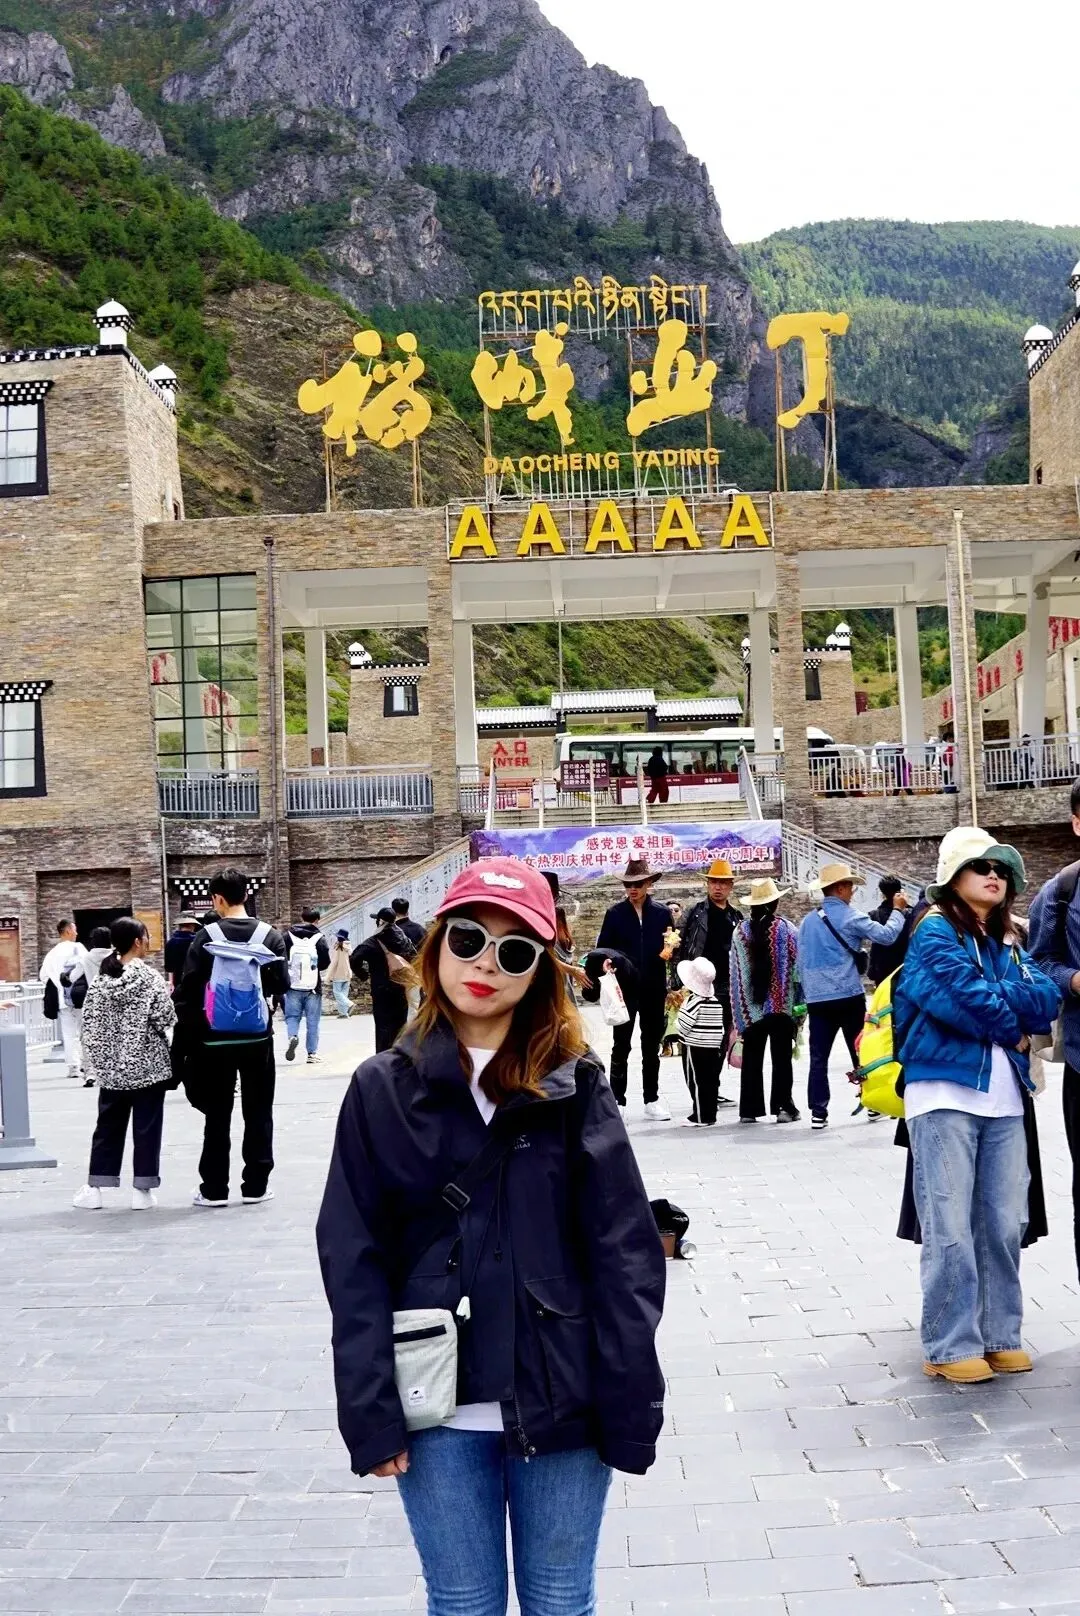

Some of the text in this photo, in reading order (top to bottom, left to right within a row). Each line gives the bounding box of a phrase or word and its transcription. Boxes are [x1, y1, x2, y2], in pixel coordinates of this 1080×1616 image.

[484, 448, 720, 475] DAOCHENG YADING
[493, 741, 527, 756] 入口
[586, 836, 674, 850] 感党恩 爱祖国
